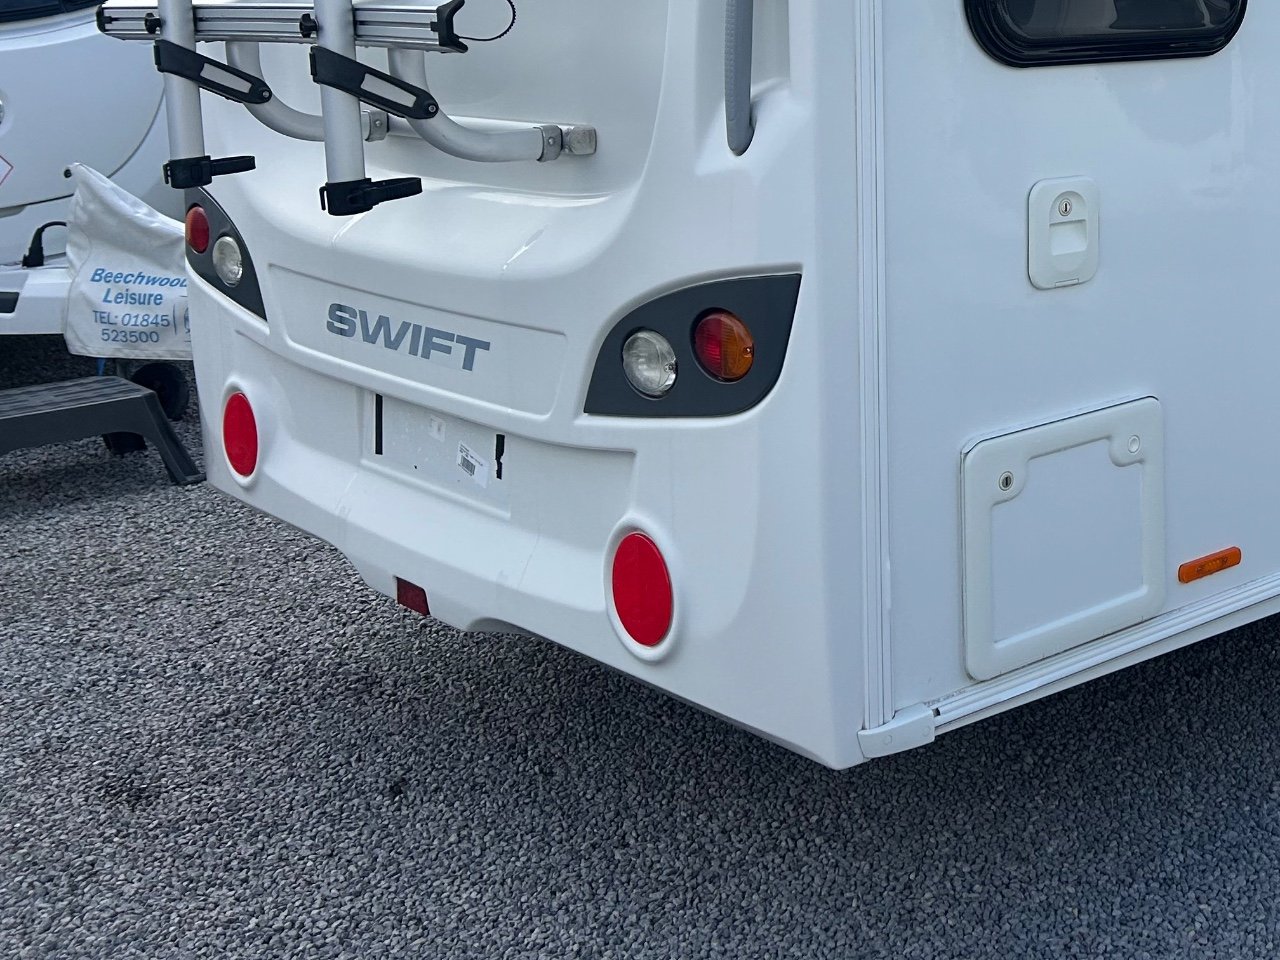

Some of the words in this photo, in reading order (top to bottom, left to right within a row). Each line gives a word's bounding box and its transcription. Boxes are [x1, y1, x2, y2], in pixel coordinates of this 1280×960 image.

[103, 288, 163, 305] Leisure
[92, 310, 118, 325] TEL:
[121, 313, 170, 327] 01845
[101, 329, 160, 343] 523500
[326, 303, 491, 371] SWIFT
